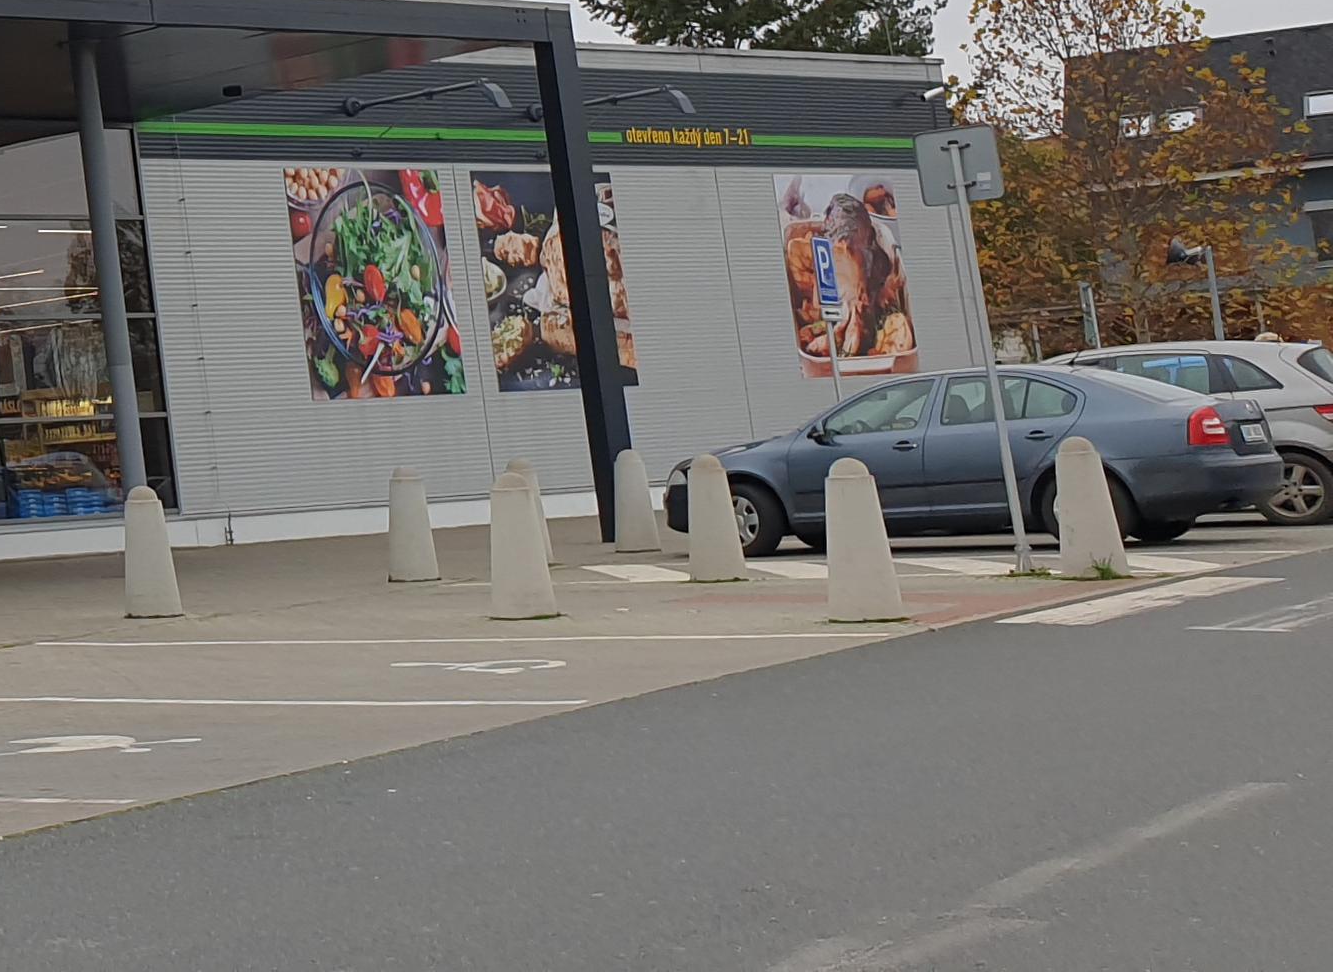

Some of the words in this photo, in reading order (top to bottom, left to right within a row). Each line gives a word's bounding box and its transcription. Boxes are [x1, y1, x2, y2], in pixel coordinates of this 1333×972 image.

[626, 126, 671, 144] otevřeno
[672, 126, 702, 148] každý
[703, 127, 722, 145] den
